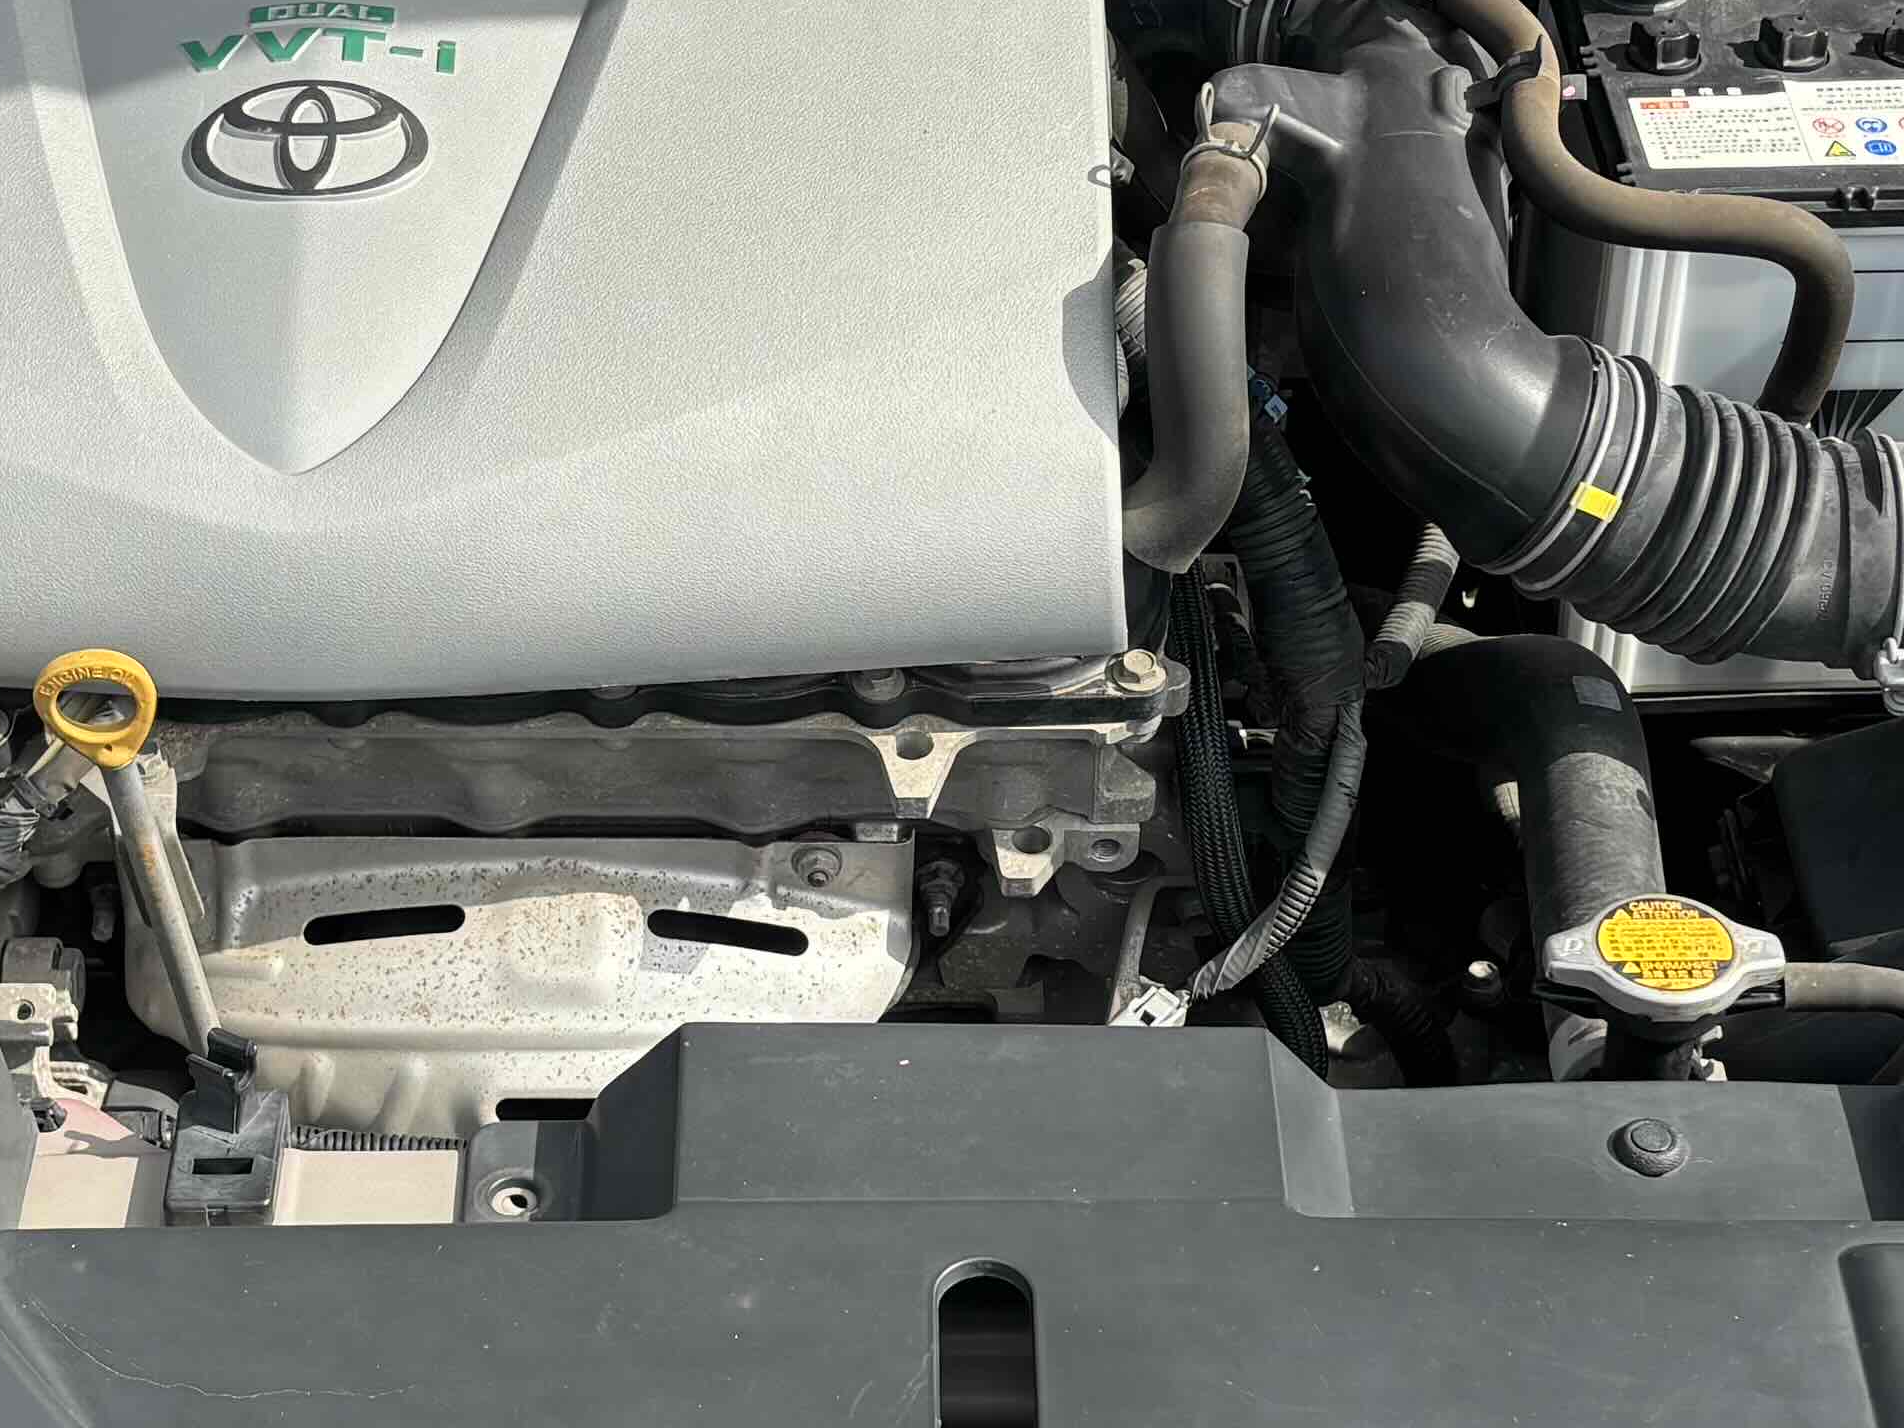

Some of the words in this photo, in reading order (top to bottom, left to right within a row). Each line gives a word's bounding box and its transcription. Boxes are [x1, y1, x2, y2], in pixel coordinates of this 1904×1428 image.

[267, 3, 383, 21] DUAL
[38, 665, 104, 697] ENGINE
[1629, 901, 1683, 911] CAUTION
[1632, 909, 1701, 920] ATTENTION
